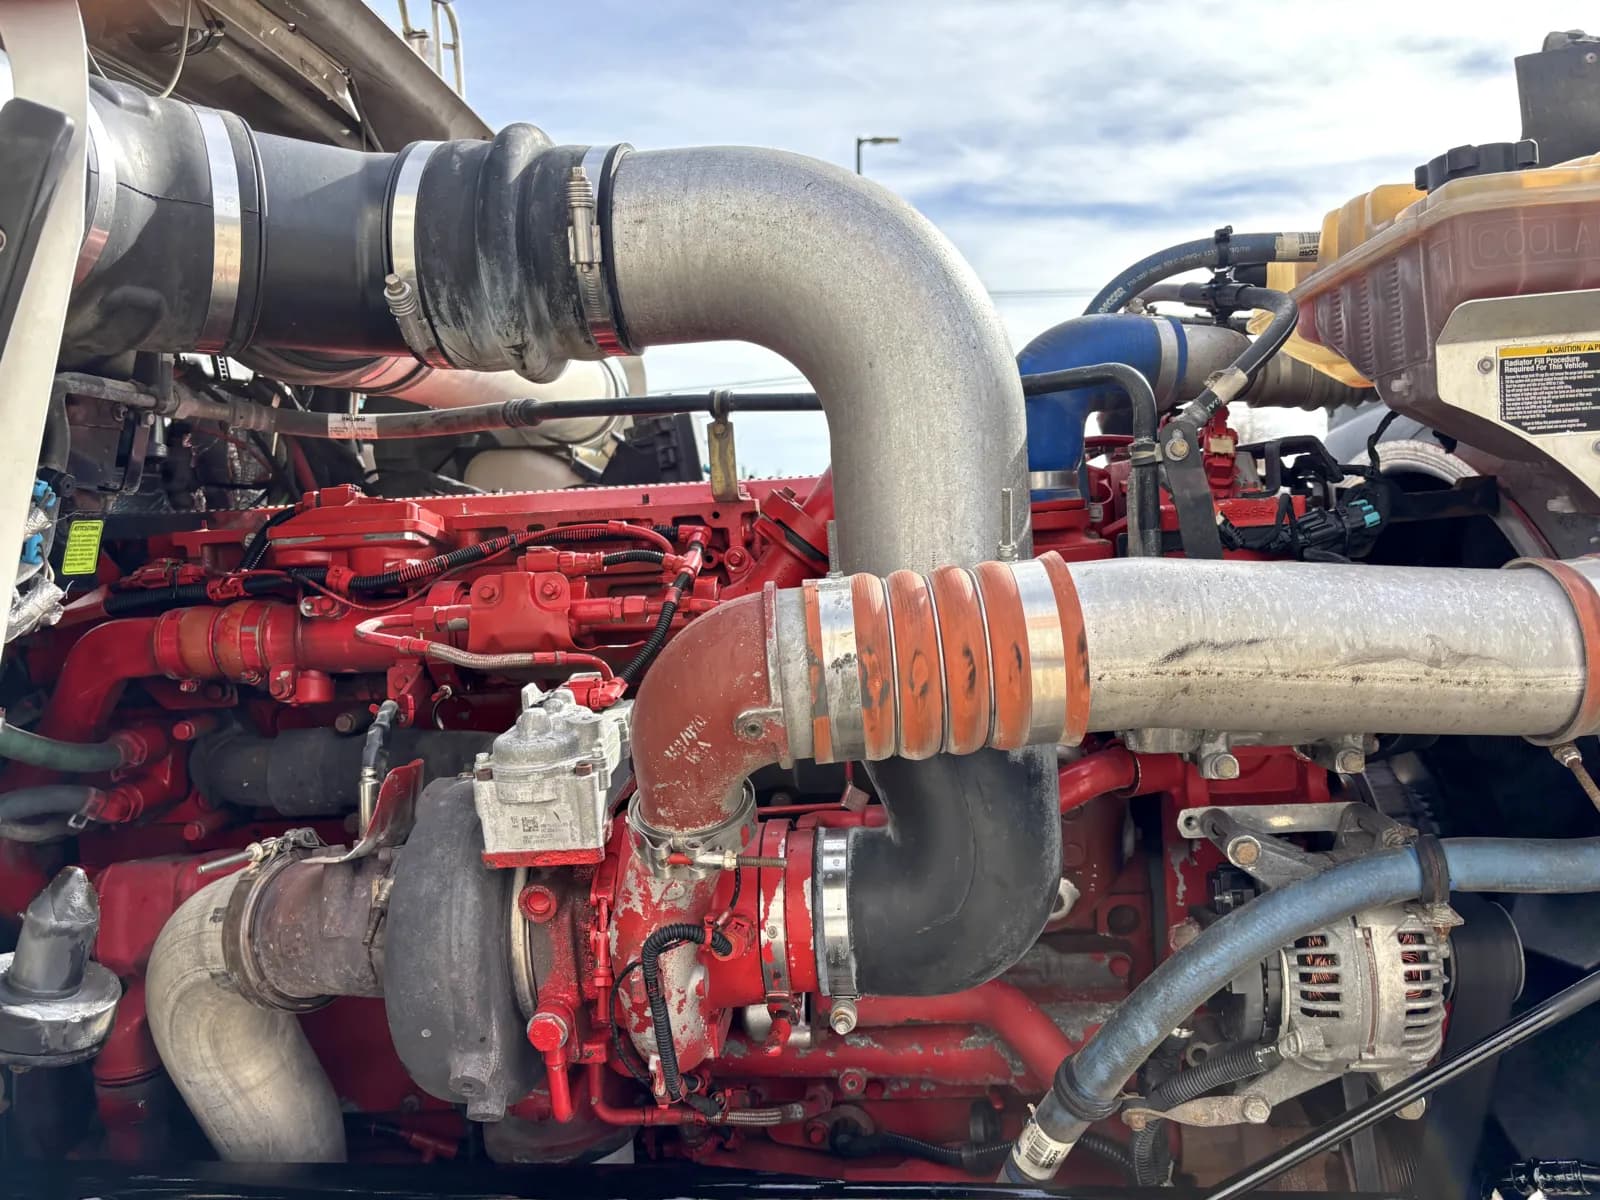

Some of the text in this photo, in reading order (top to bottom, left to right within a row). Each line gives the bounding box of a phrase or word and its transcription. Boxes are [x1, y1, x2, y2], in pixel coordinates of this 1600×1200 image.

[1553, 344, 1582, 353] CAUTION
[1534, 357, 1545, 365] Fill
[1504, 365, 1535, 373] Required
[1549, 362, 1563, 370] This
[1564, 361, 1589, 369] Vehicle
